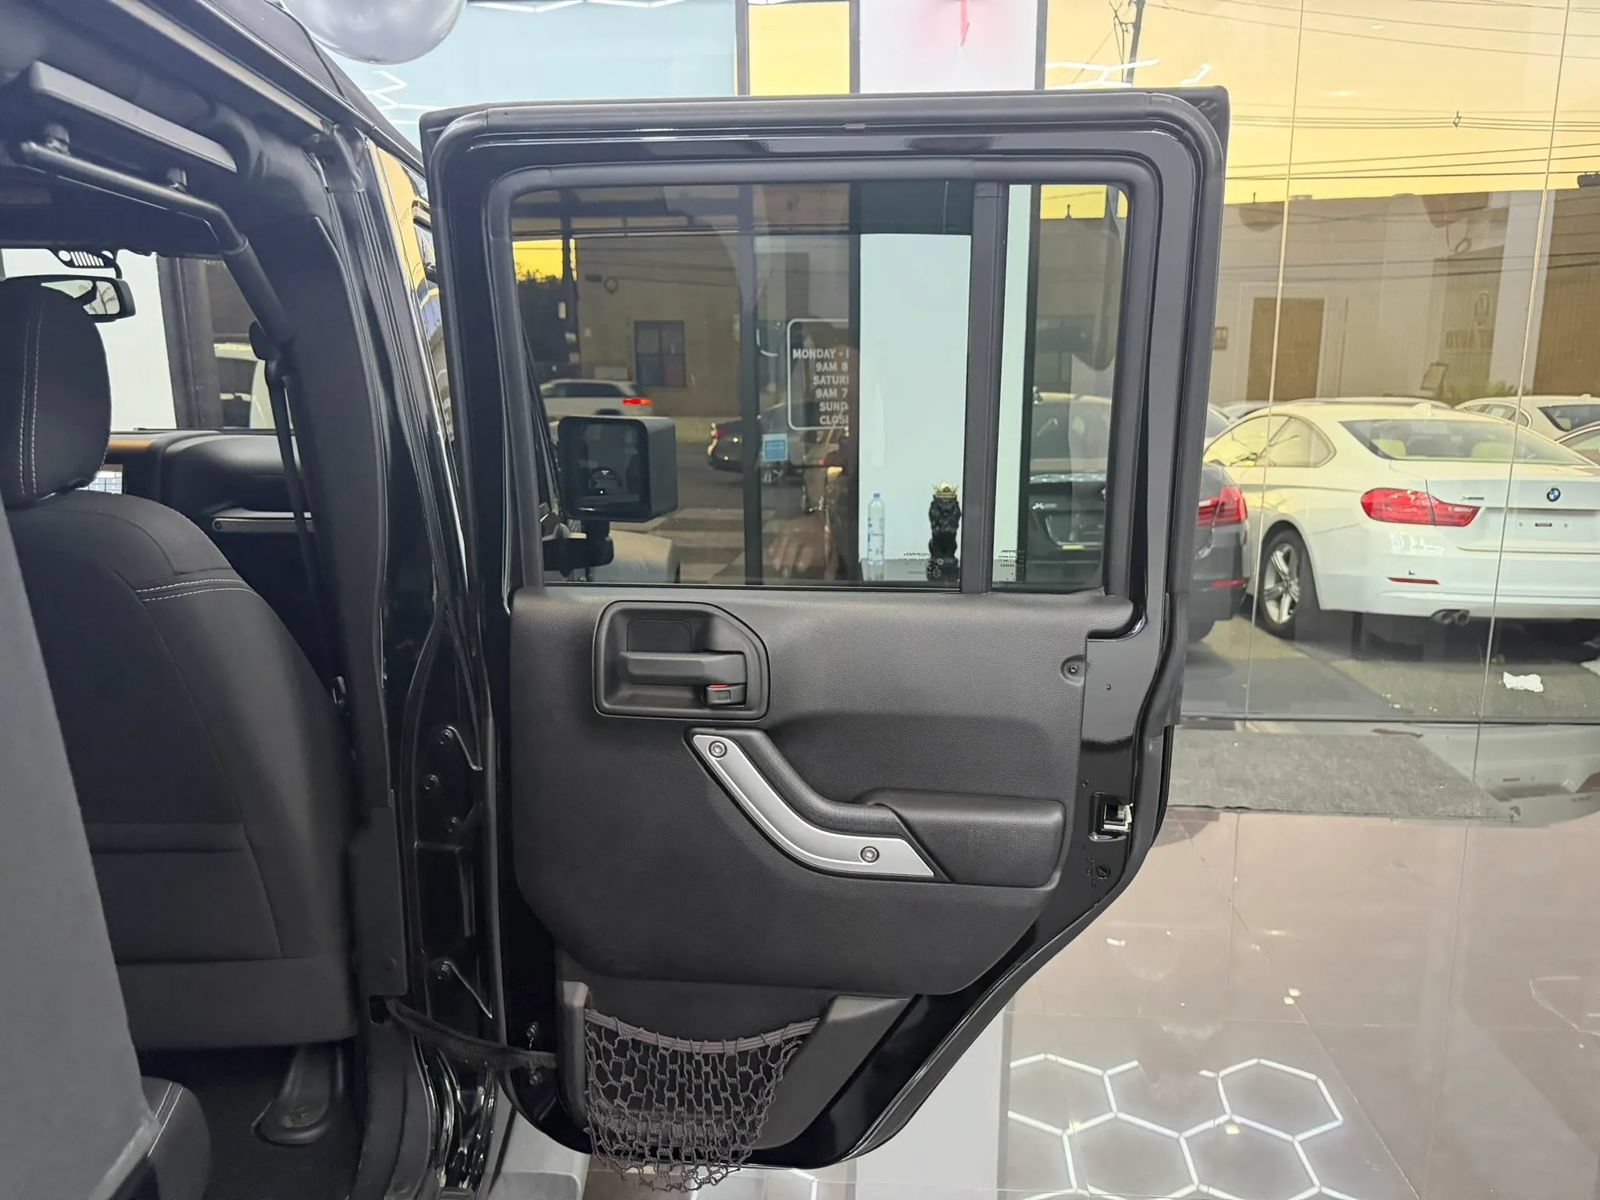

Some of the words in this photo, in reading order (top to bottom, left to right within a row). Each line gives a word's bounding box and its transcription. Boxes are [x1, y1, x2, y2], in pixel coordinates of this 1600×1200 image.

[792, 348, 836, 359] MONDAY
[816, 362, 837, 372] 9AM
[816, 388, 837, 398] 9AM
